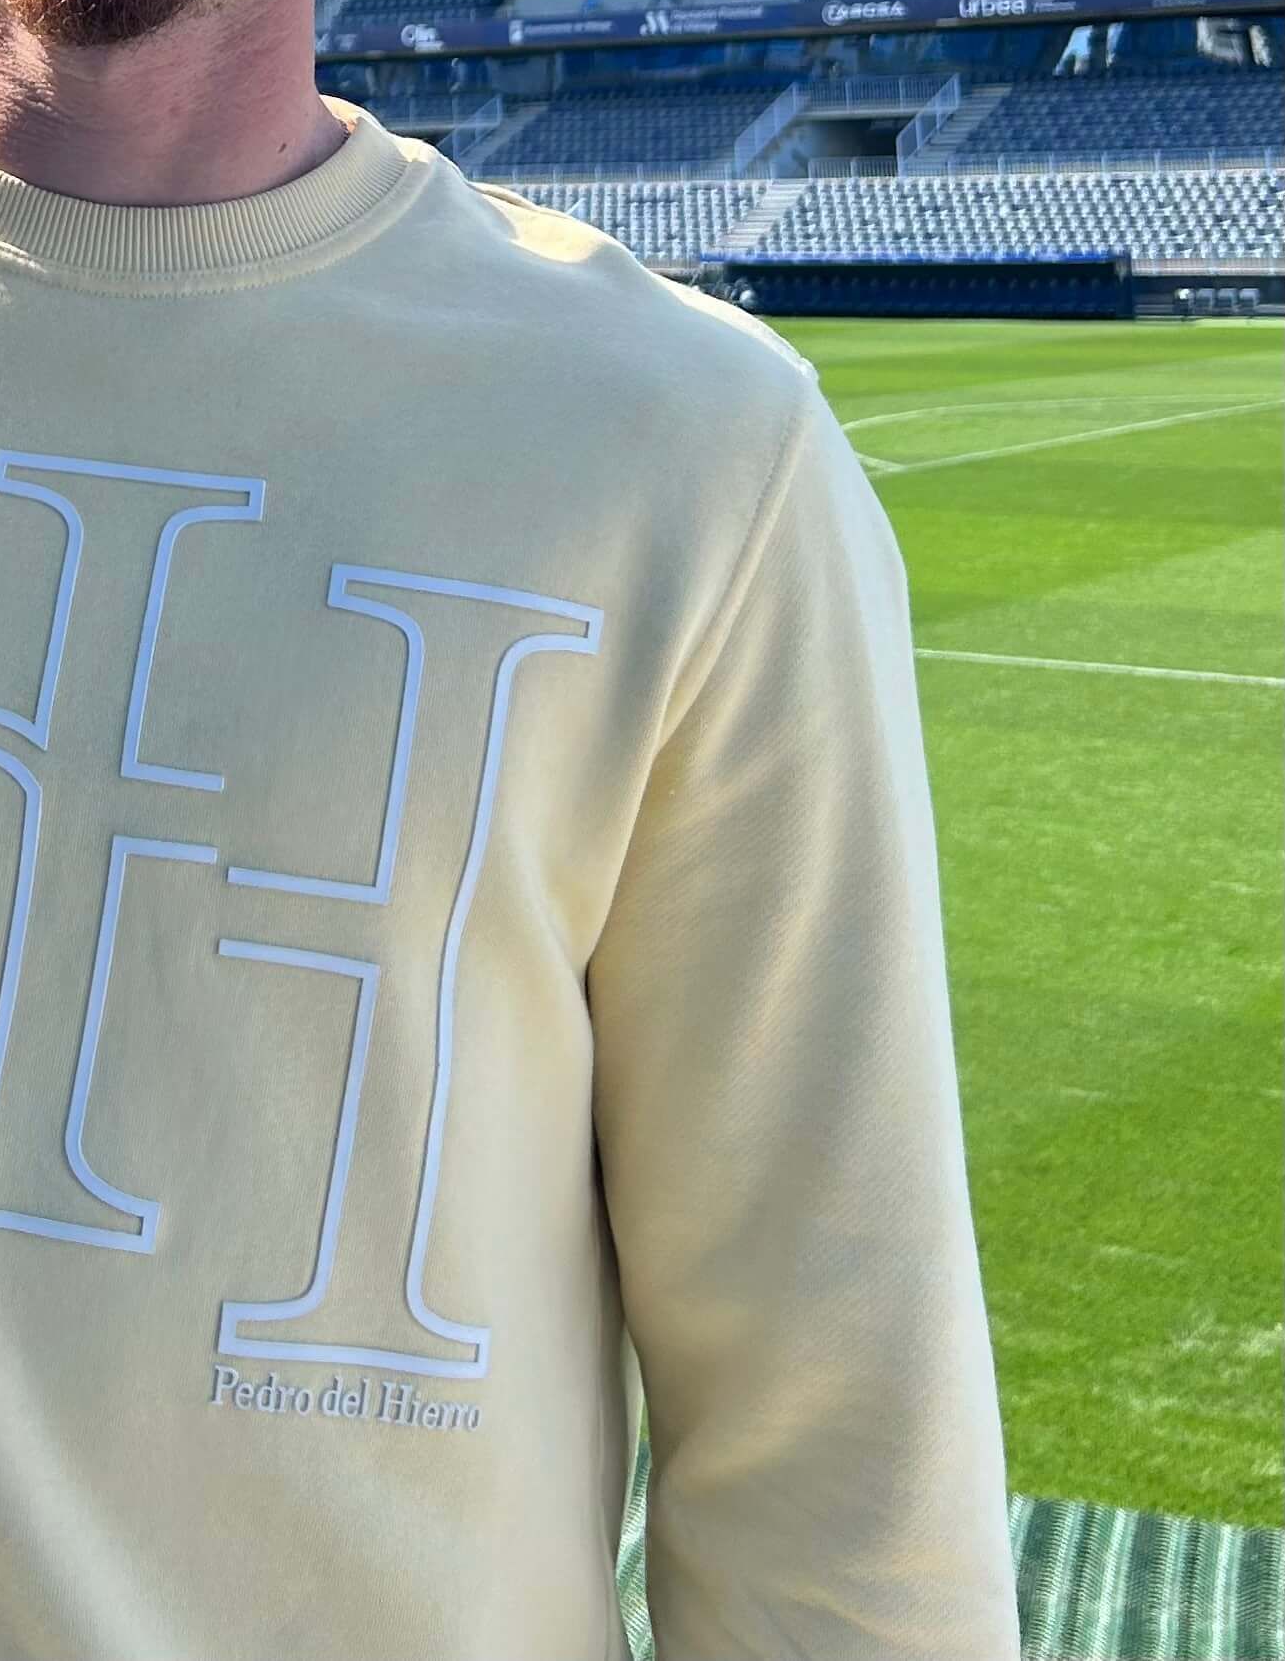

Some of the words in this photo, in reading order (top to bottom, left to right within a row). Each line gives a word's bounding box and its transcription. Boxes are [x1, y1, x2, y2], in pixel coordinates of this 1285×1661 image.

[211, 1364, 313, 1417] Pedro
[321, 1375, 370, 1419] del
[378, 1380, 482, 1432] Hierro
